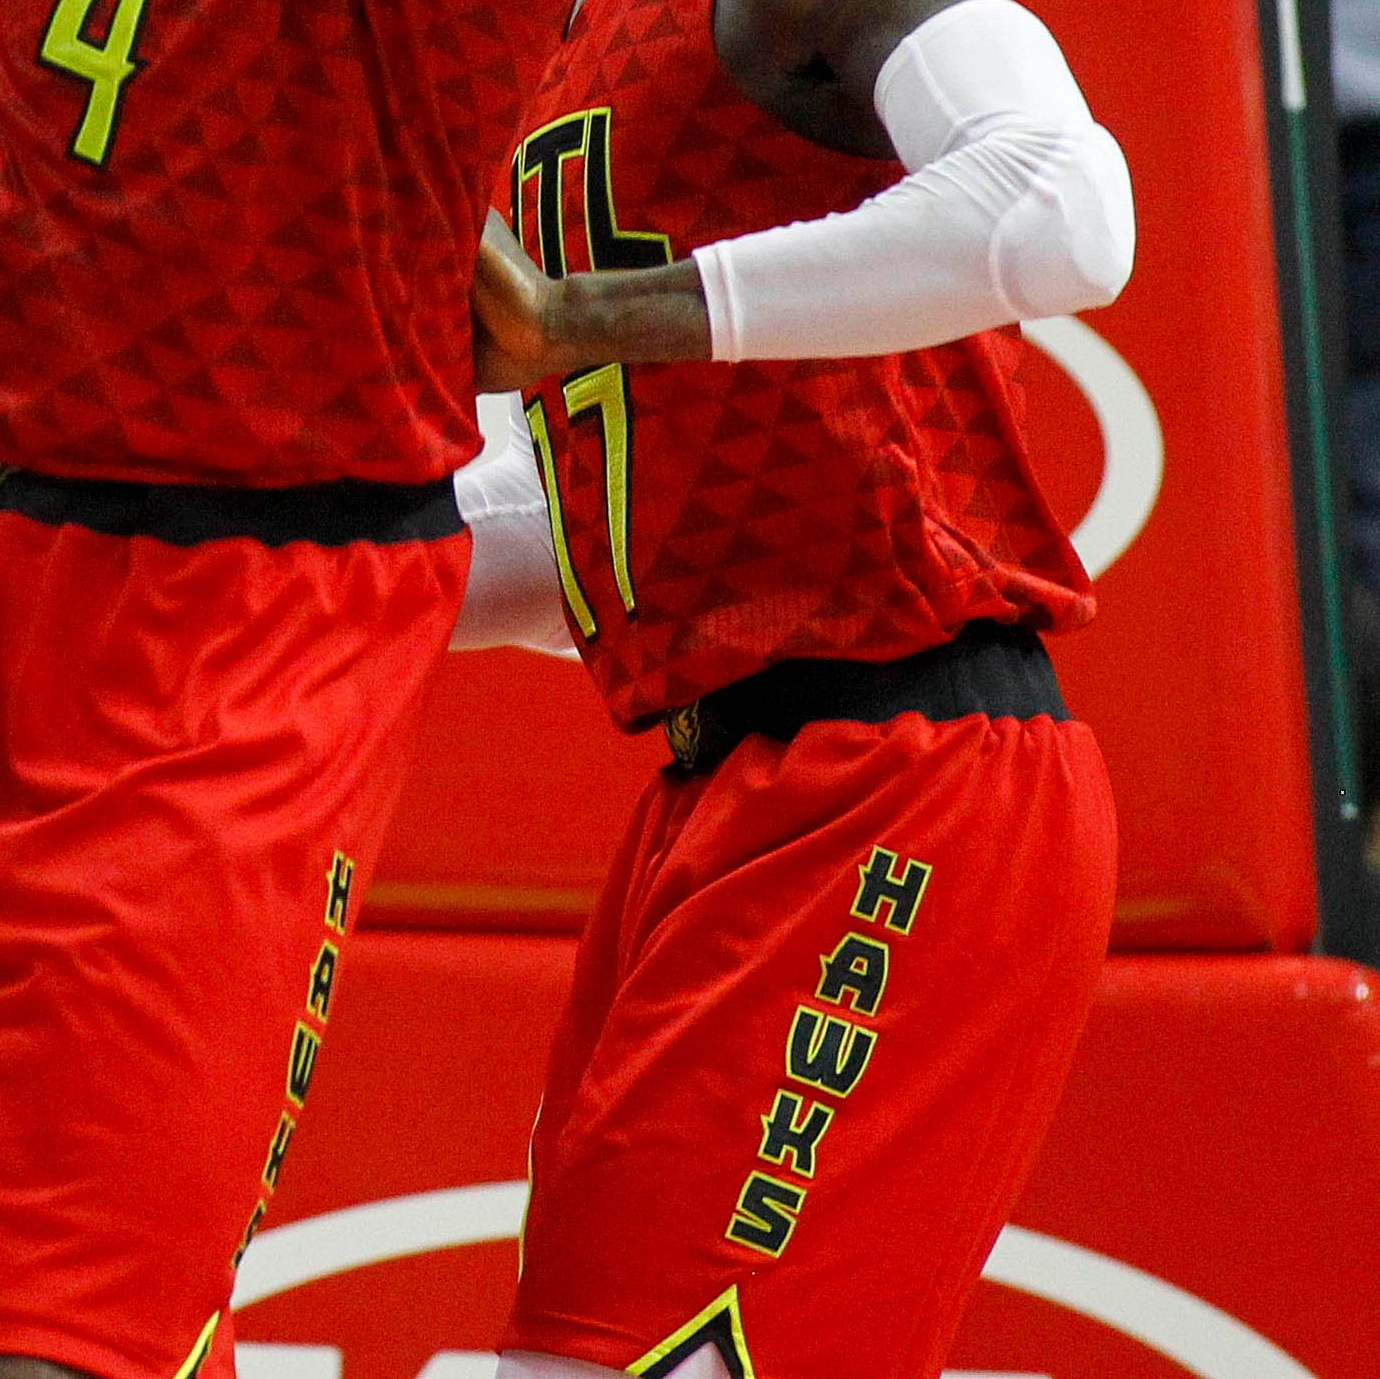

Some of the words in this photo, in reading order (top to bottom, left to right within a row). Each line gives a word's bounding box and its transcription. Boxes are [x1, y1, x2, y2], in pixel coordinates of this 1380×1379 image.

[511, 106, 674, 280] TL
[524, 362, 638, 642] 17
[724, 845, 932, 1259] HAWKS
